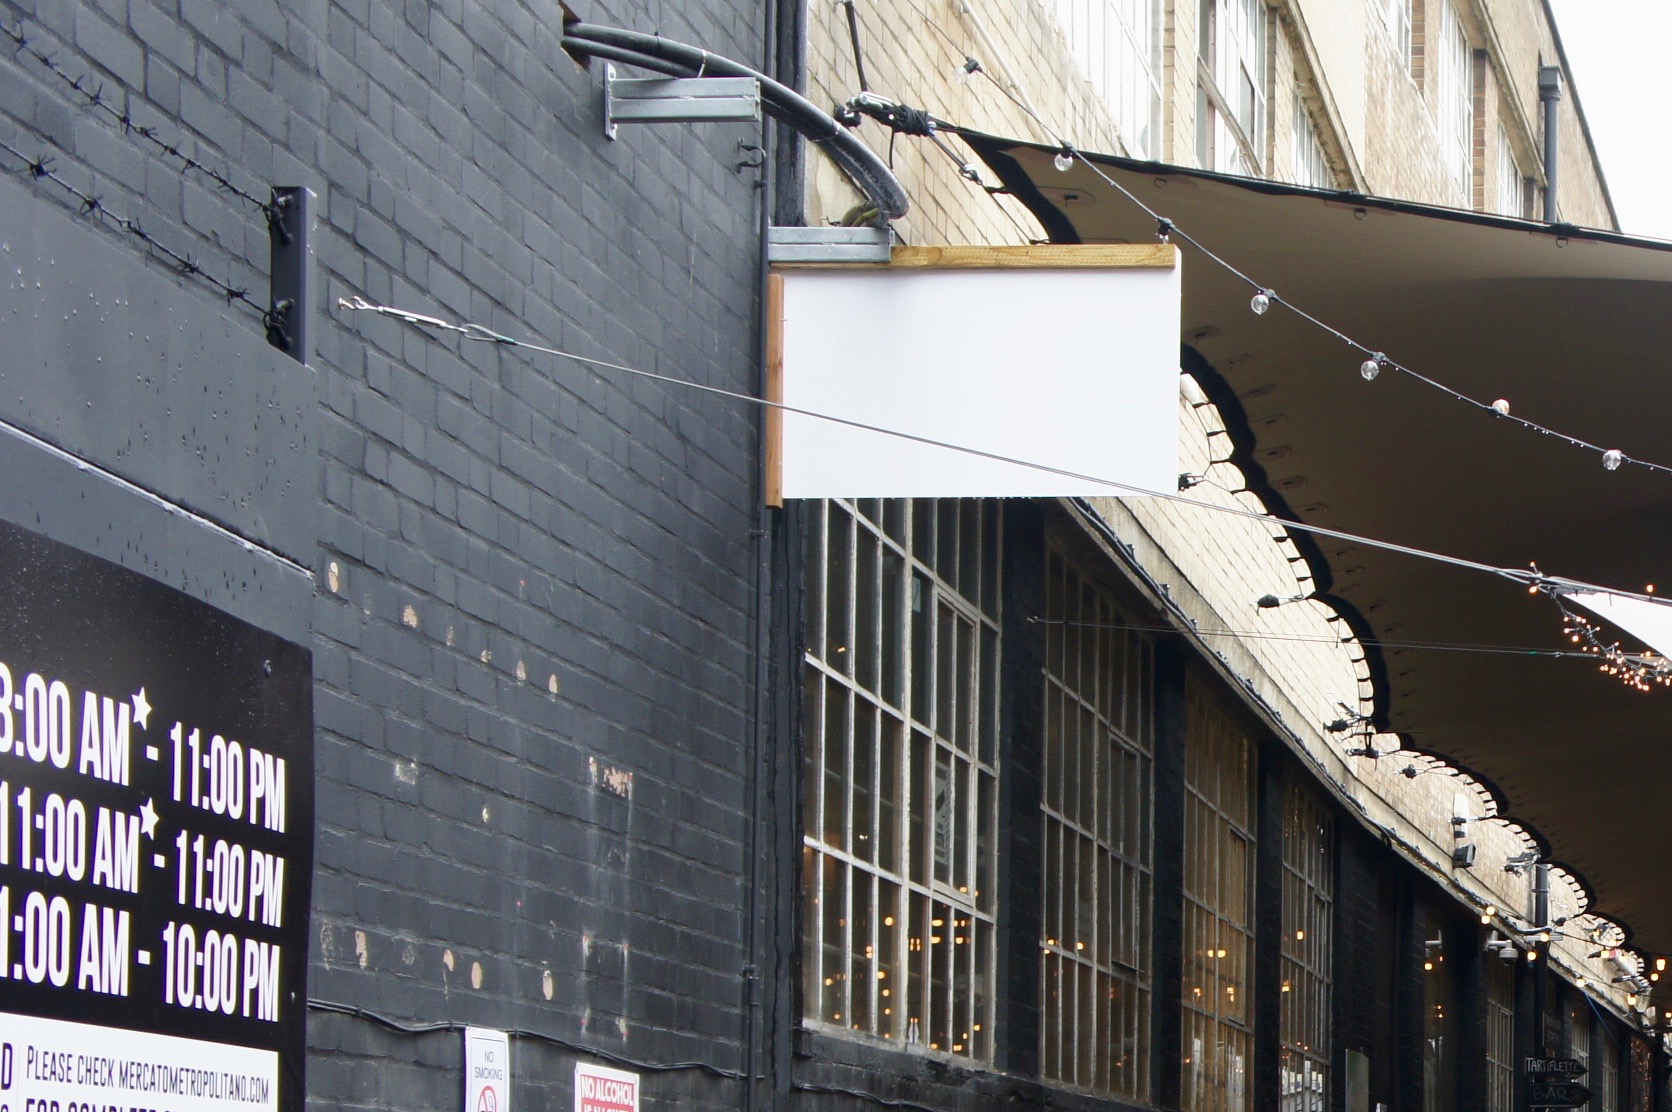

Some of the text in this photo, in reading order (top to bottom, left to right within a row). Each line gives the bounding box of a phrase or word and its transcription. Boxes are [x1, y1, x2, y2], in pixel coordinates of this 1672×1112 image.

[79, 691, 130, 787] AM
[170, 721, 243, 820] 11:00
[249, 748, 285, 833] PM
[93, 807, 139, 893] AM
[176, 829, 244, 918] 11:00
[249, 850, 284, 928] PM
[78, 903, 130, 997] AM
[163, 921, 237, 1014] 10:00
[244, 938, 280, 1022] PM
[27, 1045, 270, 1105] PLEASE CHECK MERCATOMETROPOLITANO.COM
[474, 1066, 503, 1081] SMOKING
[484, 1051, 494, 1062] NO
[1526, 1057, 1580, 1073] TARTIFLETTE
[582, 1076, 634, 1107] NO ALCOHOL
